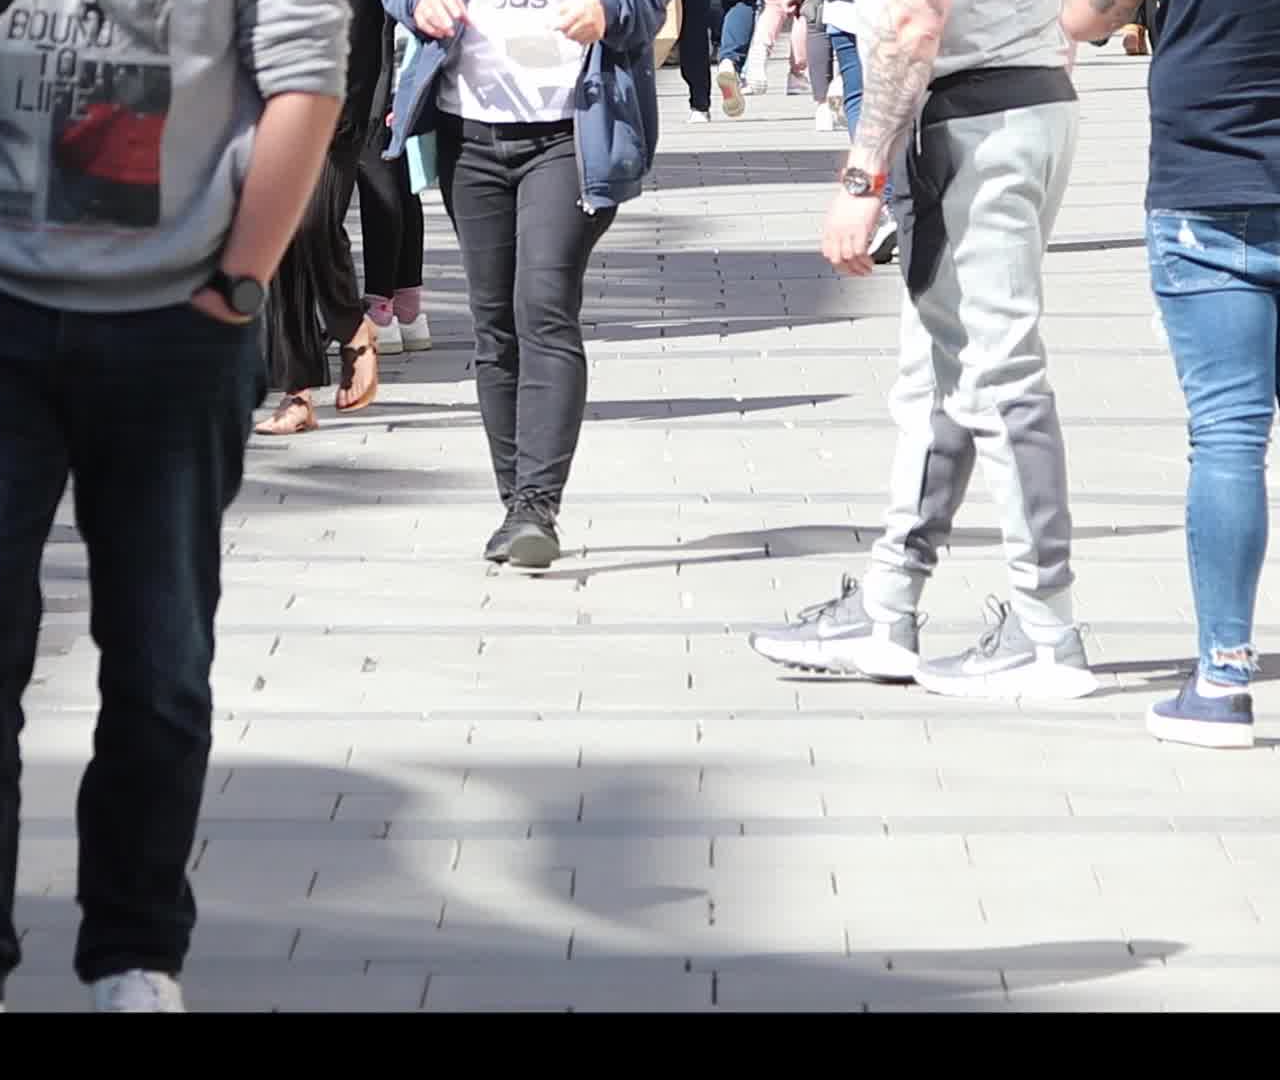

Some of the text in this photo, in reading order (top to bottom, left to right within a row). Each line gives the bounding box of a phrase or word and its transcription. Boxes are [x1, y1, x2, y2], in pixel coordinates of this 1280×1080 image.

[7, 8, 113, 48] BOUND
[34, 43, 77, 78] TO
[14, 78, 93, 120] LIFE
